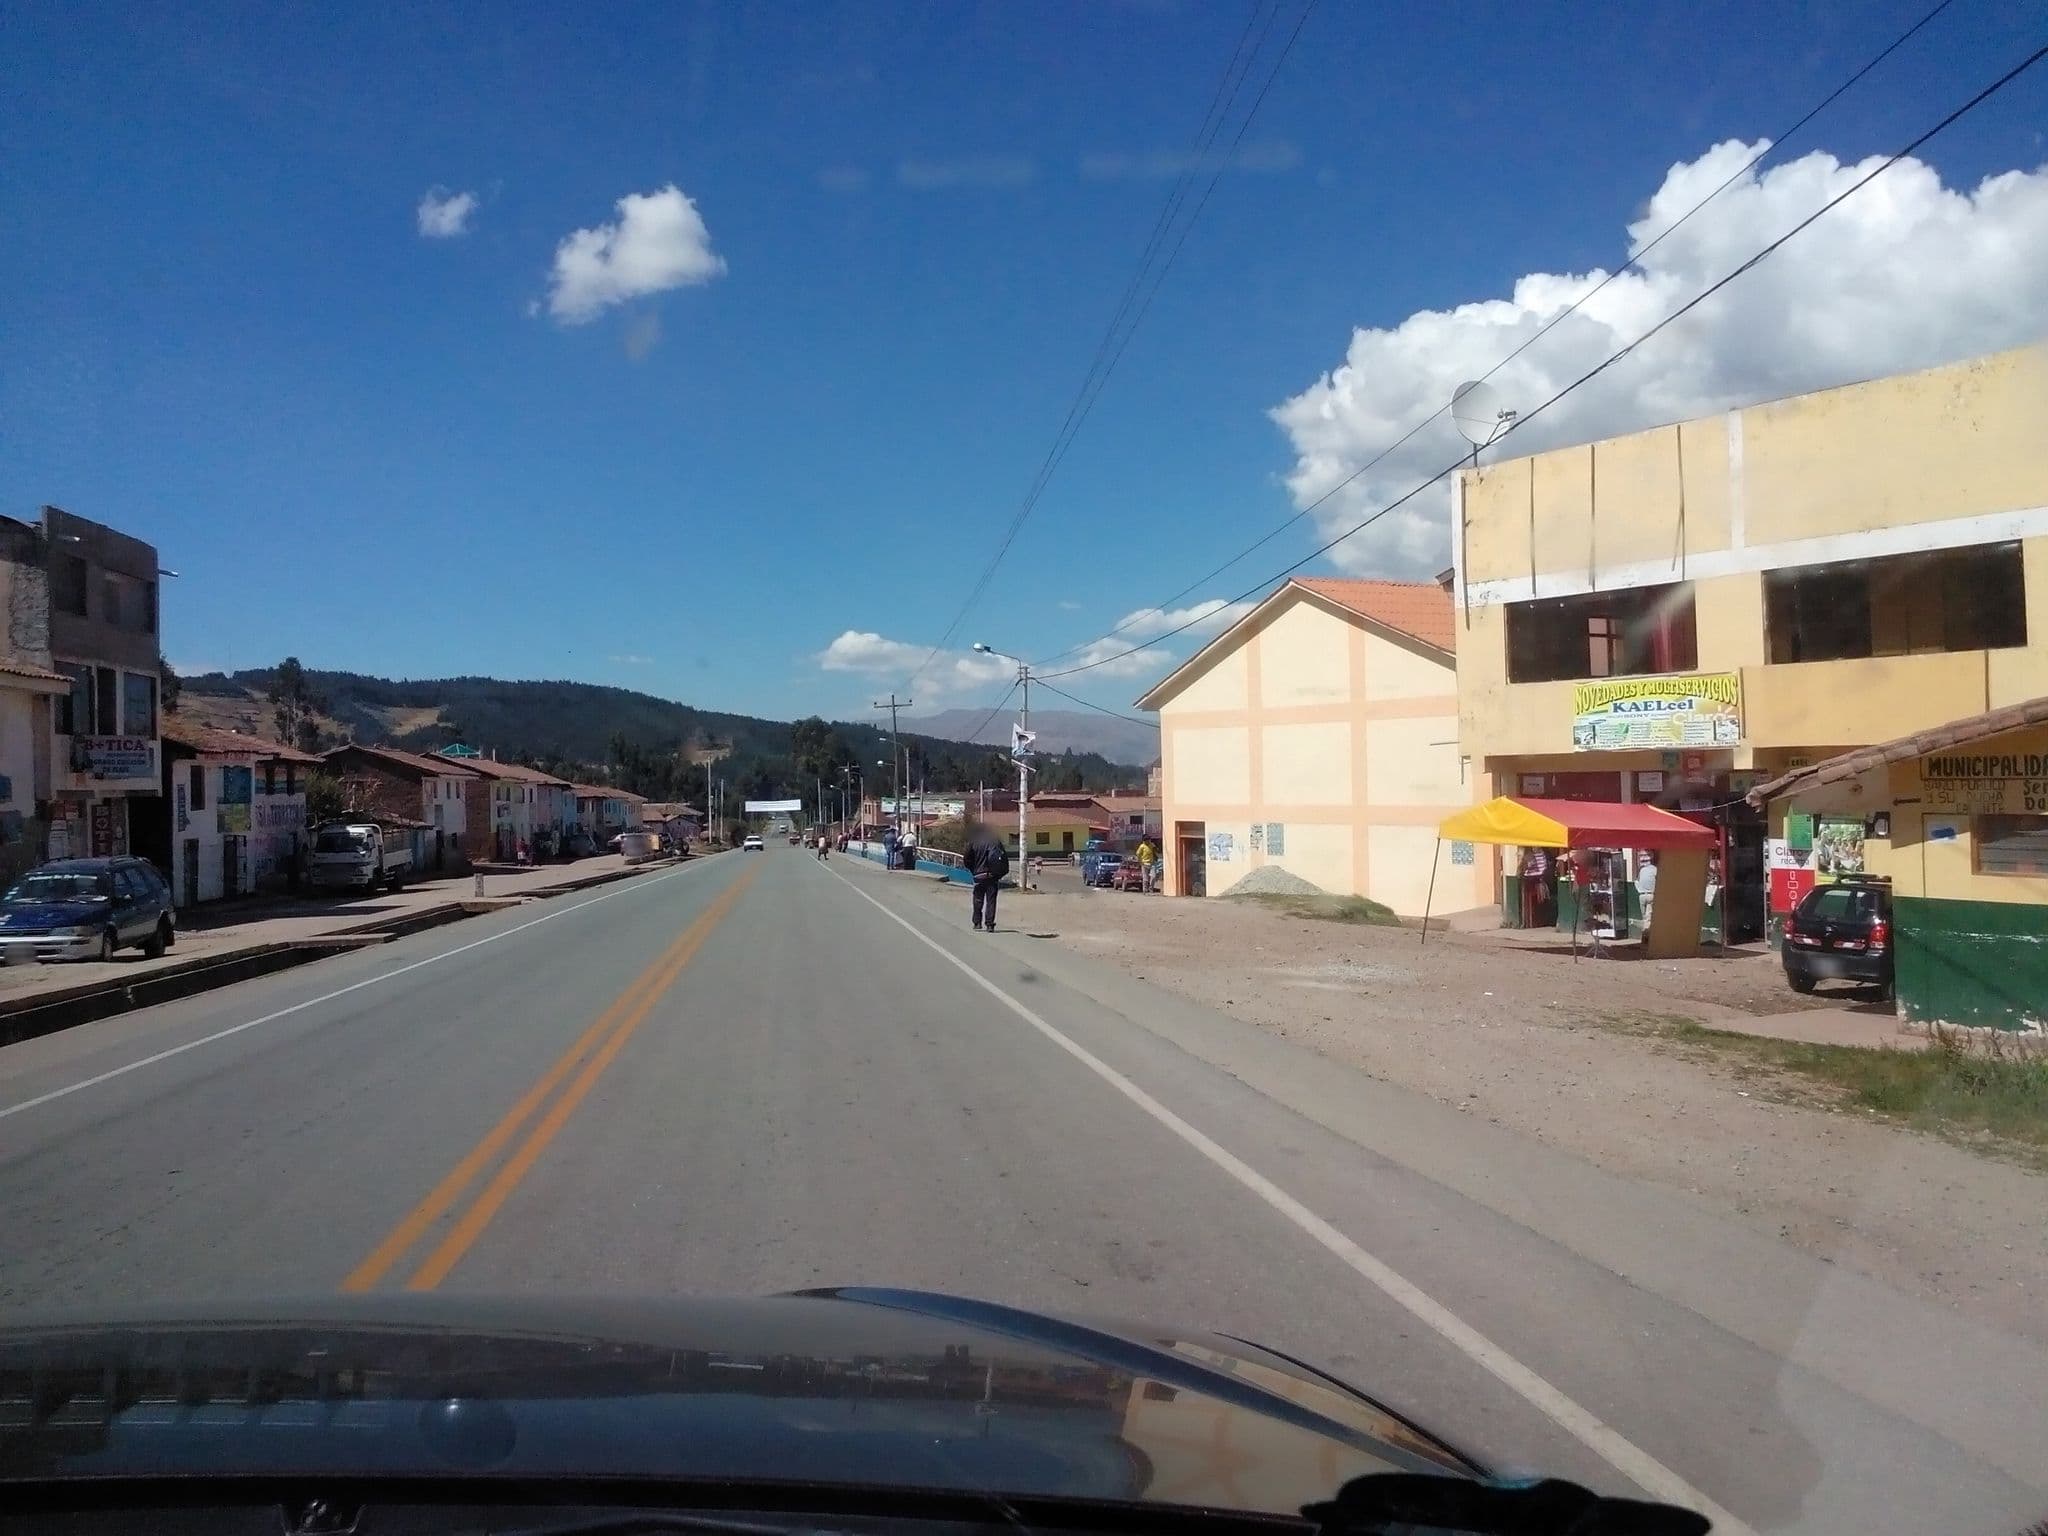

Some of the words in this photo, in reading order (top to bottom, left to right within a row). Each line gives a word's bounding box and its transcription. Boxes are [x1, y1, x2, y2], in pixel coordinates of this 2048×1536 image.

[1575, 683, 1637, 715] NOVEDADES
[1637, 682, 1646, 696] Y
[1648, 677, 1738, 707] MULTISERVICIOS
[1612, 699, 1694, 713] KAELcel
[1672, 710, 1726, 725] Claro
